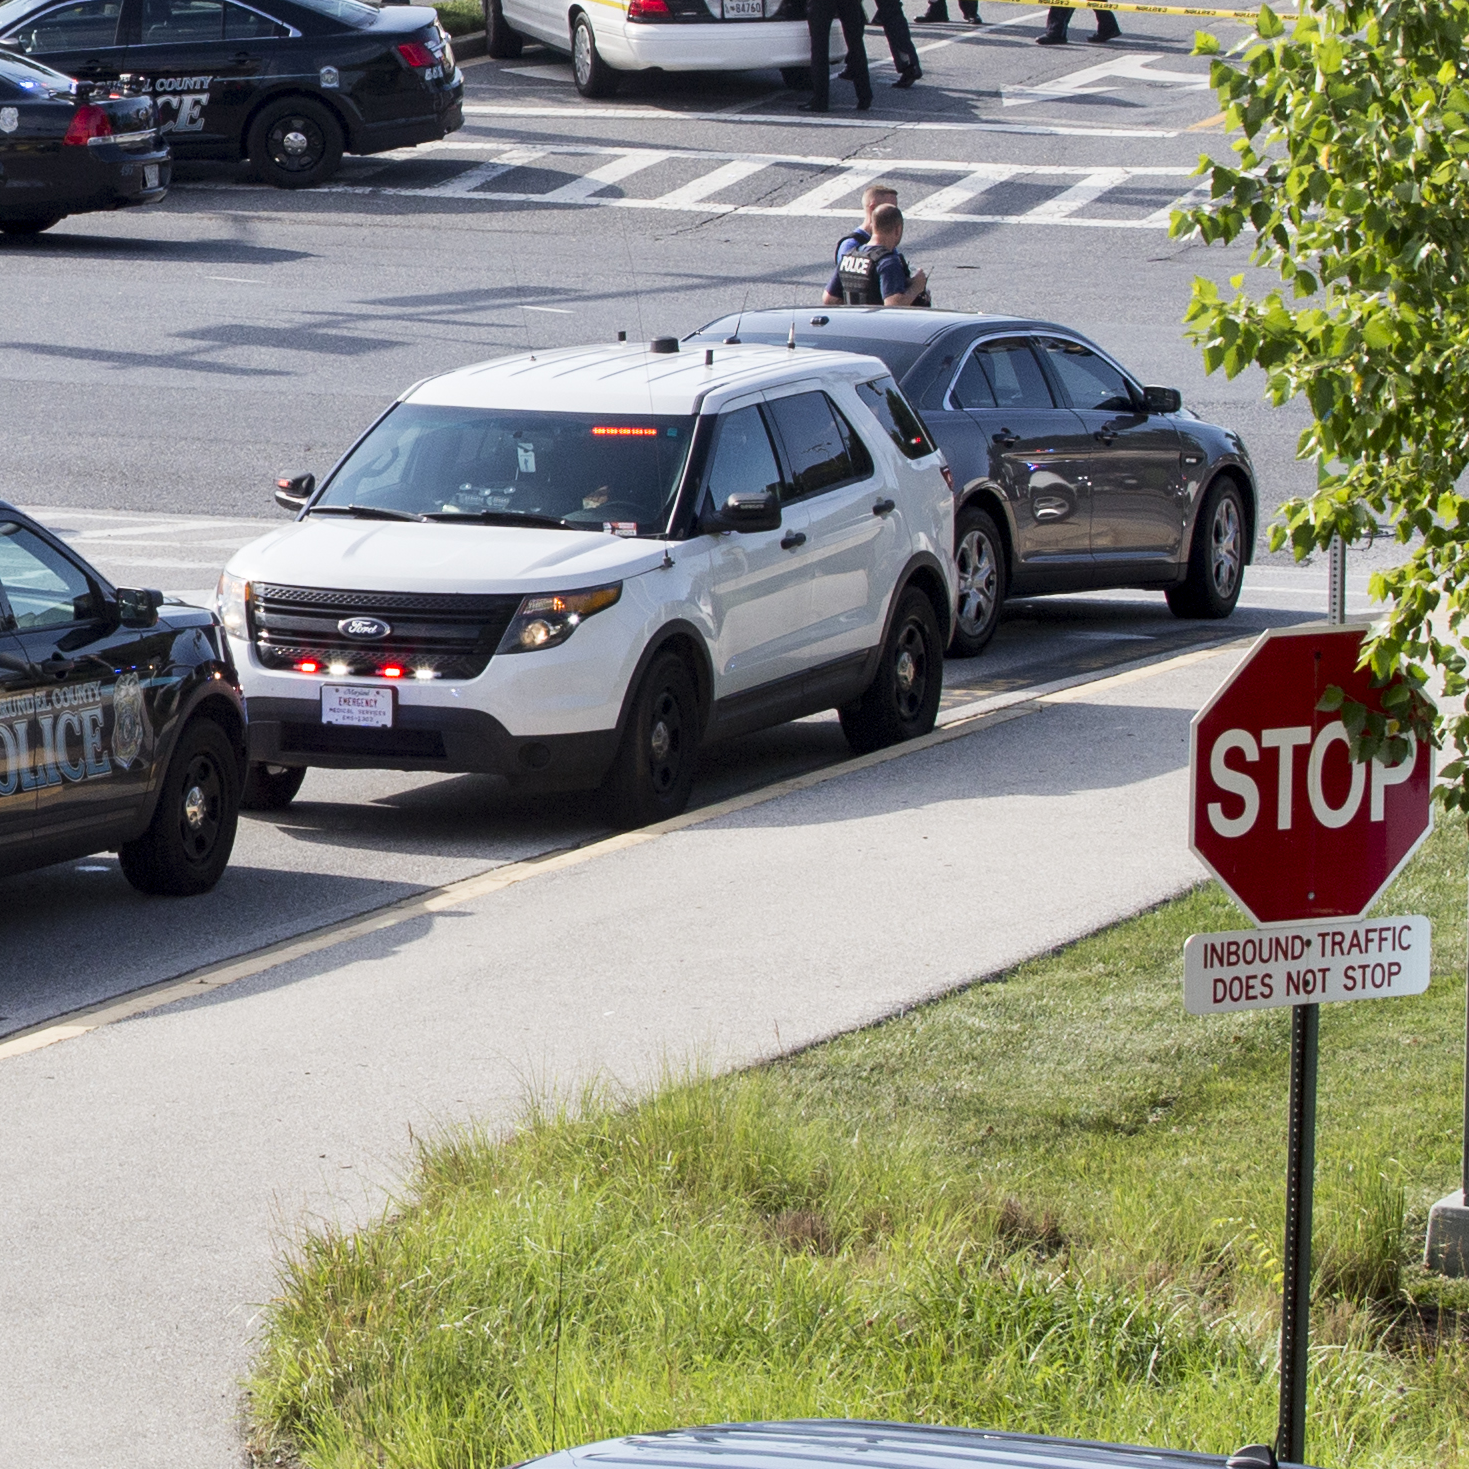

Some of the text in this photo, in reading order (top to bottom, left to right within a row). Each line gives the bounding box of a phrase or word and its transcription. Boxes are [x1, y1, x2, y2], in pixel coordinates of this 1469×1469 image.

[735, 1, 761, 14] 84760
[155, 75, 214, 92] COUNTY
[840, 255, 871, 275] POLICE
[348, 620, 378, 634] Ford
[52, 680, 102, 709] COUNTY
[338, 697, 378, 708] EMERGENCY
[357, 708, 386, 716] SERVICES
[1207, 720, 1418, 839] STOP
[1203, 925, 1413, 969] INBOUND TRAFFIC
[1212, 961, 1402, 1005] DOES NOT STOP
